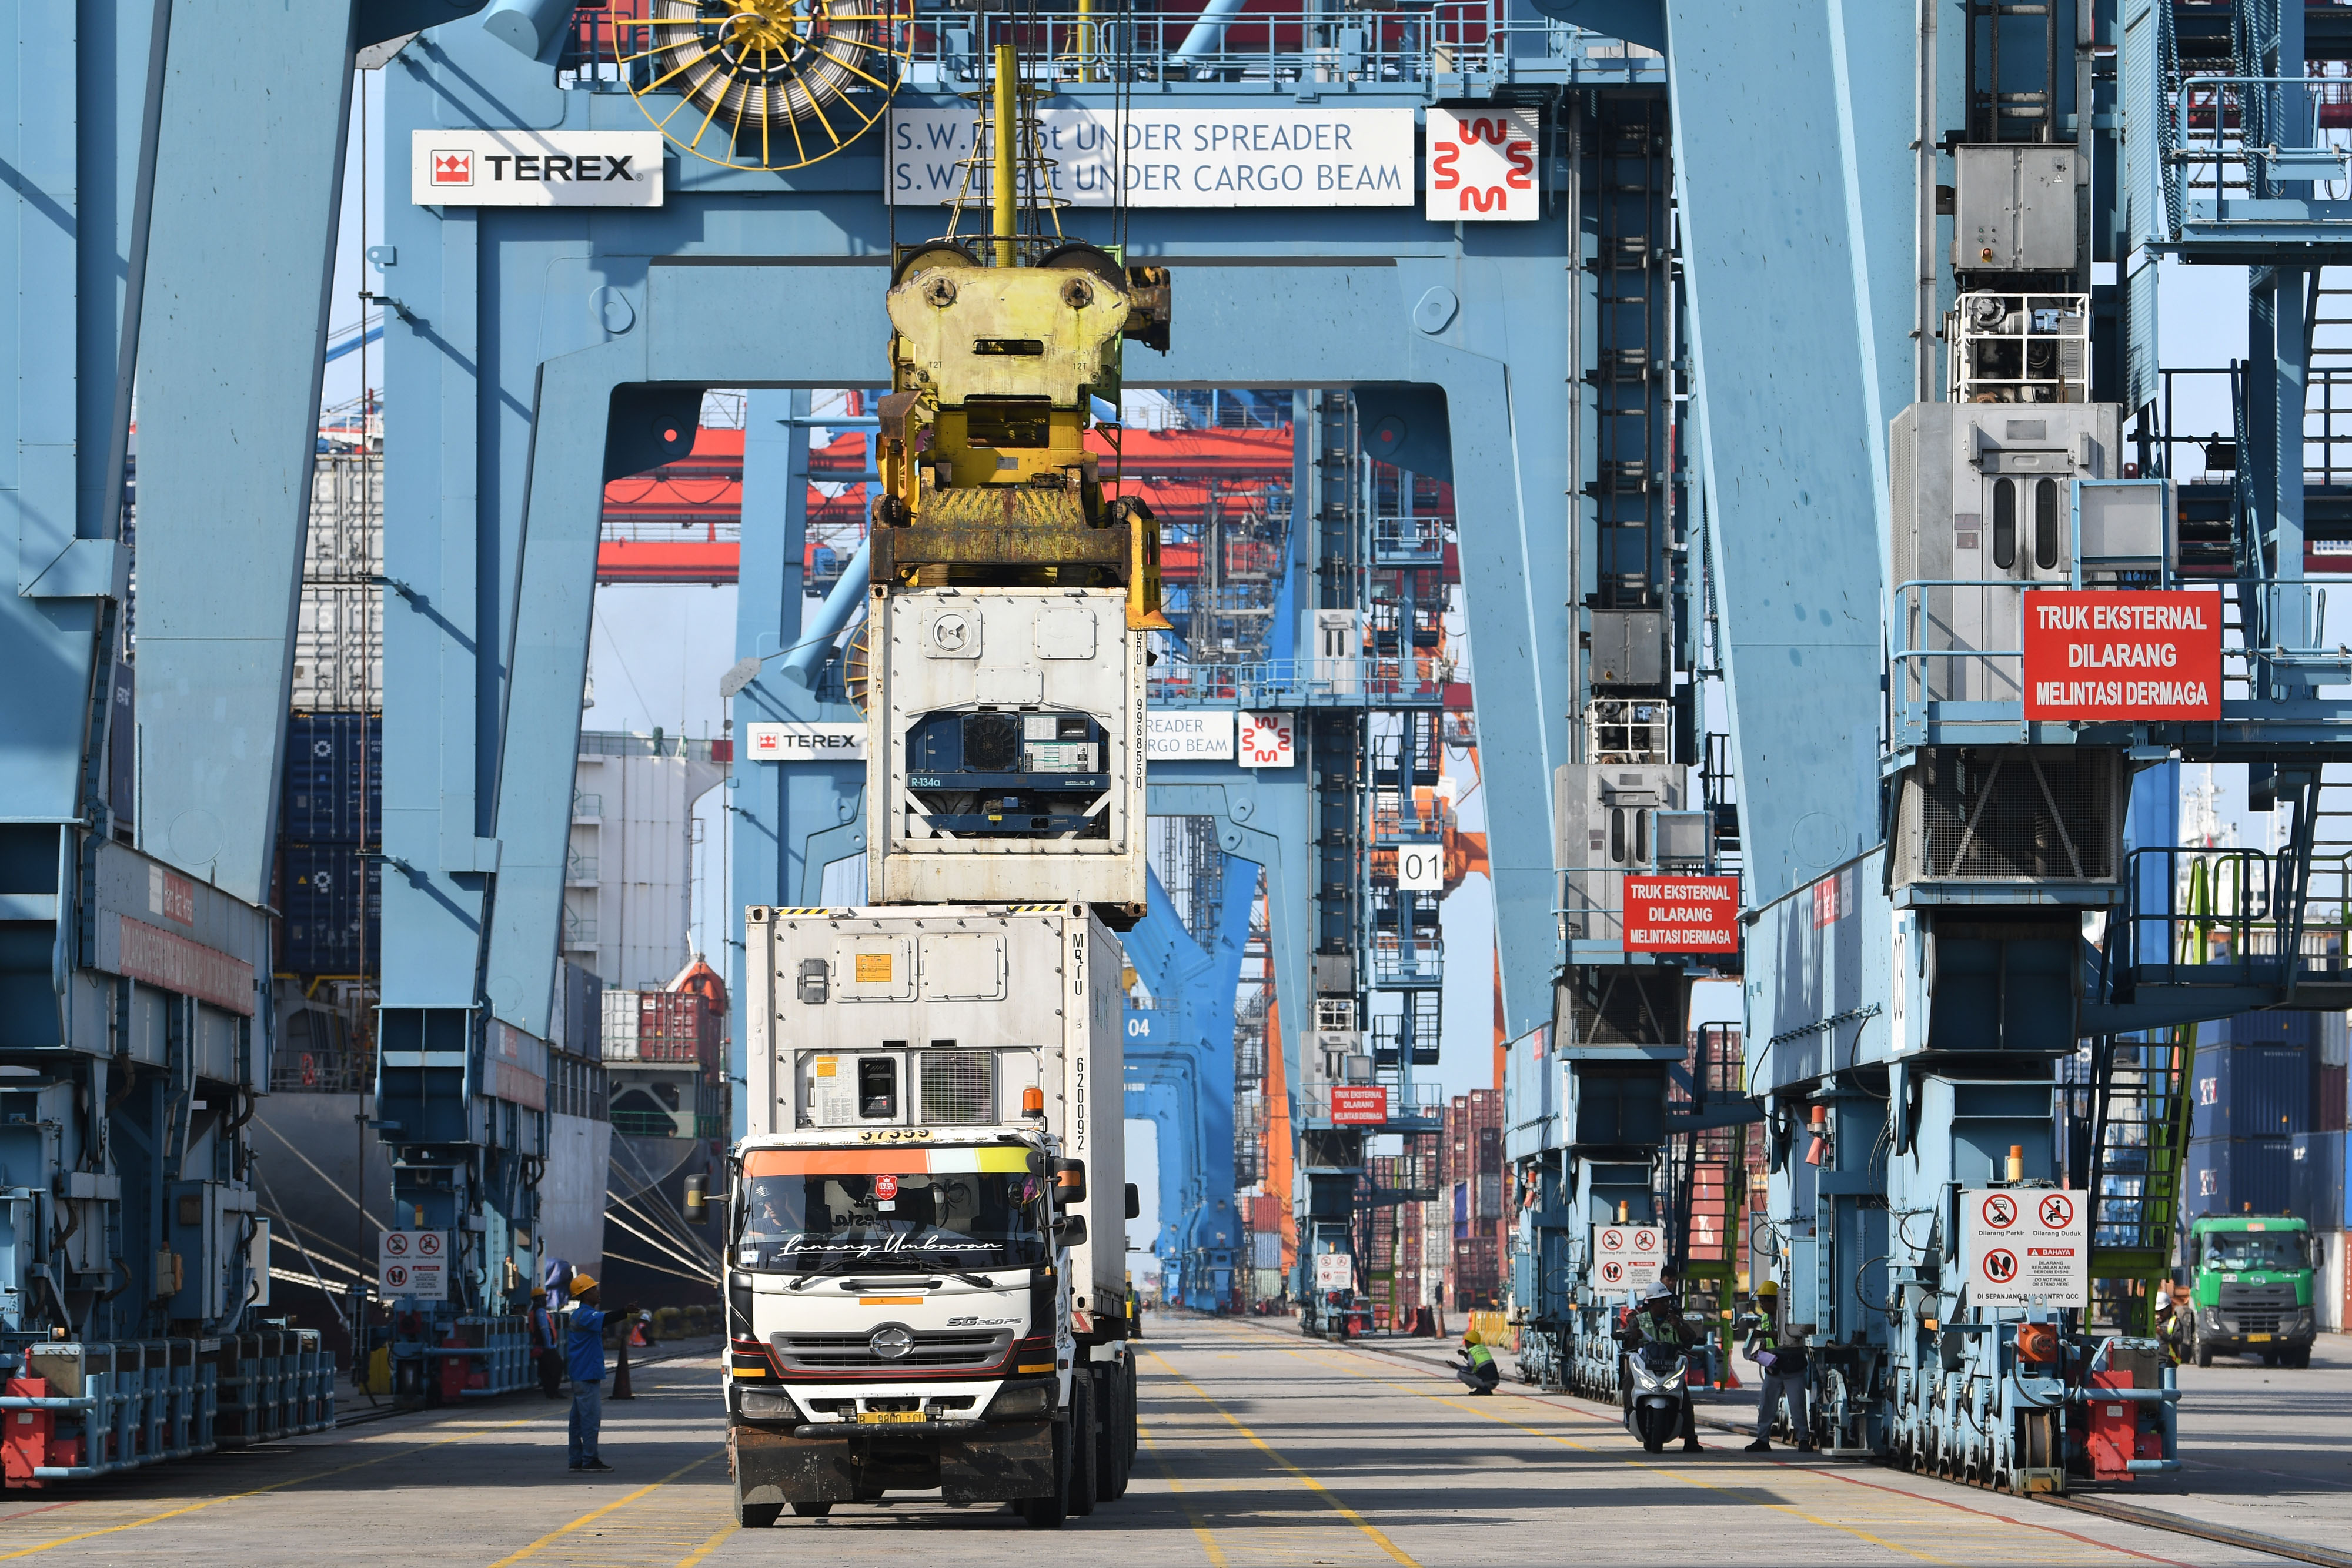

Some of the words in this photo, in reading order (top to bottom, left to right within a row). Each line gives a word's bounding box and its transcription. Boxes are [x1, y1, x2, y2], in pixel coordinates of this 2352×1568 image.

[1077, 123, 1182, 151] UNDER
[1194, 123, 1353, 151] SPREADER
[485, 155, 634, 181] TEREX
[897, 163, 994, 190] S.WL.
[1076, 163, 1182, 191] UNDER
[1194, 164, 1304, 192] CARGO
[1317, 163, 1402, 191] BEAM
[1073, 362, 1087, 370] 12T
[2036, 606, 2089, 630] TRUK
[2094, 606, 2207, 630] EKSTERNAL
[2069, 643, 2176, 667] DILARANG
[2036, 681, 2122, 706] MELINTASI
[2126, 681, 2209, 706] DERMAGA
[783, 735, 856, 748] TEREX
[1187, 739, 1227, 752] BEAM
[911, 778, 940, 787] R-134a
[1406, 854, 1437, 880] 01
[1631, 885, 1662, 899] TRUK
[1664, 885, 1730, 900] EKSTERNAL
[1649, 907, 1712, 922] DILARANG
[1630, 929, 1681, 944] MELINTASI
[1682, 930, 1731, 944] DERMAGA
[1893, 935, 1903, 1021] 03
[1128, 1018, 1150, 1037] 04
[946, 1316, 978, 1326] SG
